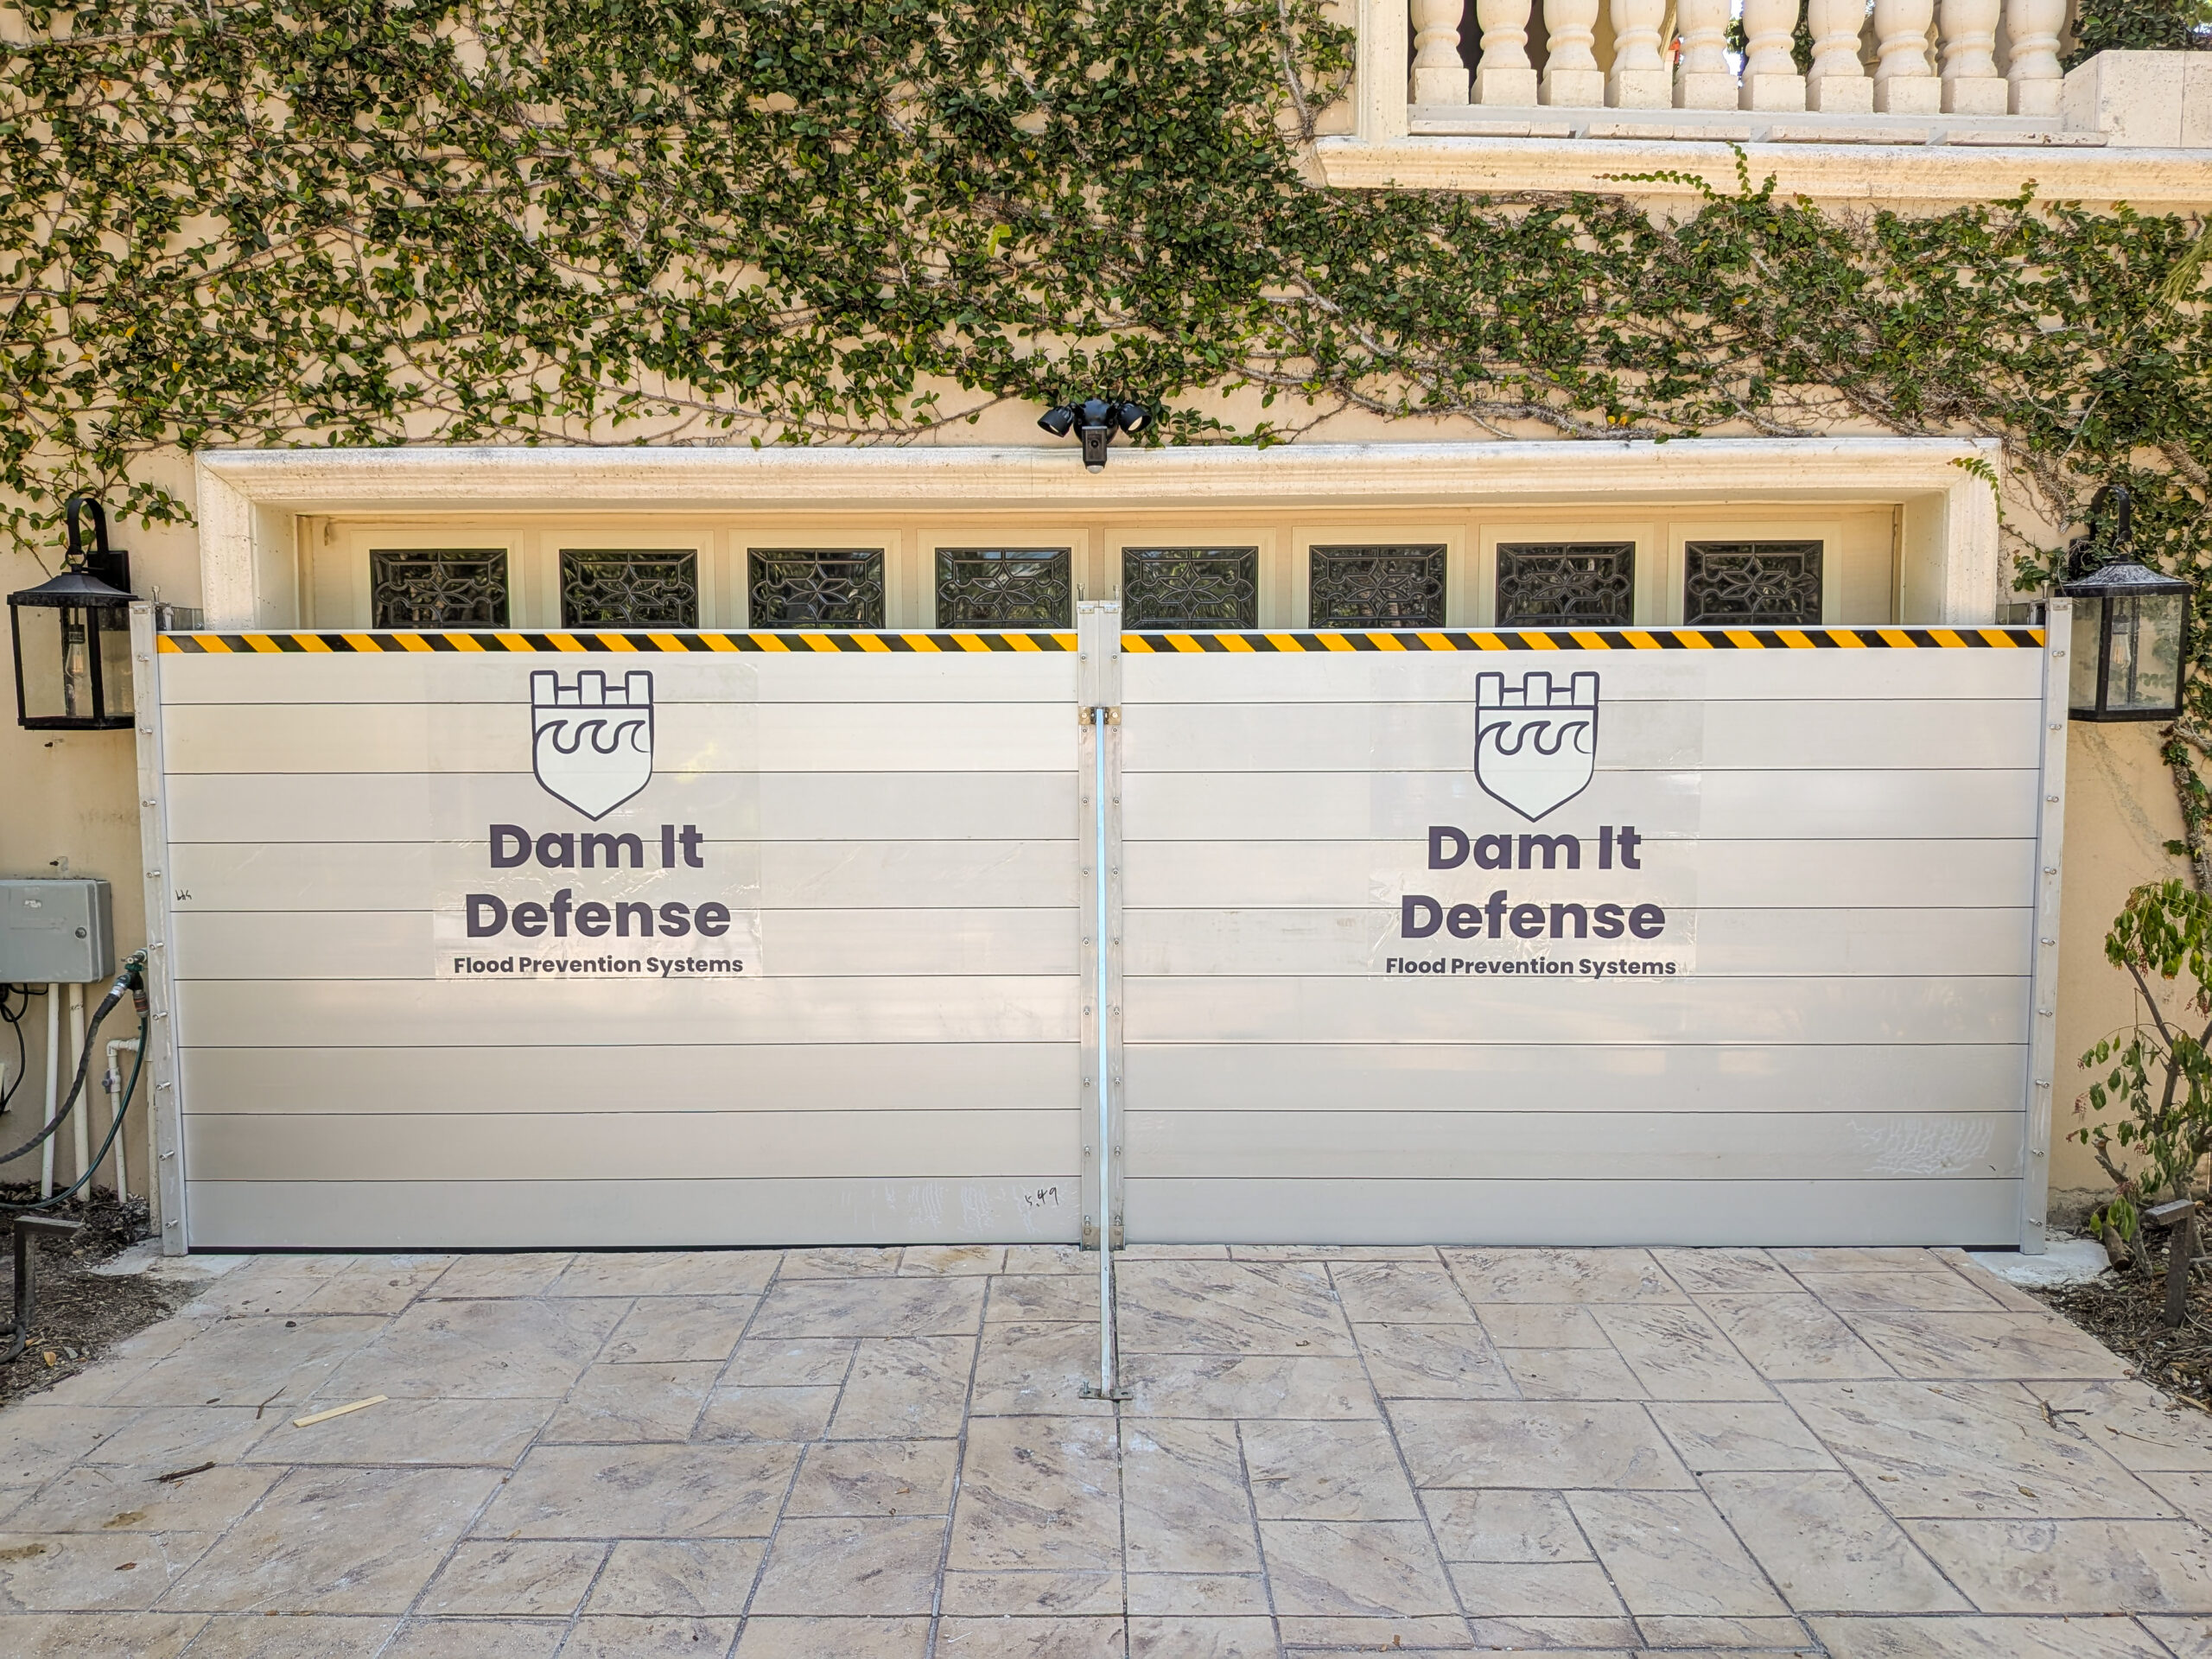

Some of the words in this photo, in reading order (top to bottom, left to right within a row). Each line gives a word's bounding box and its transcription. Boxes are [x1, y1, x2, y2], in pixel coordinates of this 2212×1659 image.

[489, 823, 645, 869] Dam
[661, 823, 704, 869] It
[1427, 825, 1581, 870] Dam
[1599, 825, 1642, 870] It
[466, 888, 731, 938] Defense
[1401, 890, 1666, 939] Defense
[454, 956, 514, 974] Flood
[519, 955, 641, 974] Prevention
[646, 955, 744, 978] Systems
[1386, 957, 1446, 975] Flood
[1451, 956, 1573, 976] Prevention
[1579, 957, 1677, 980] Systems
